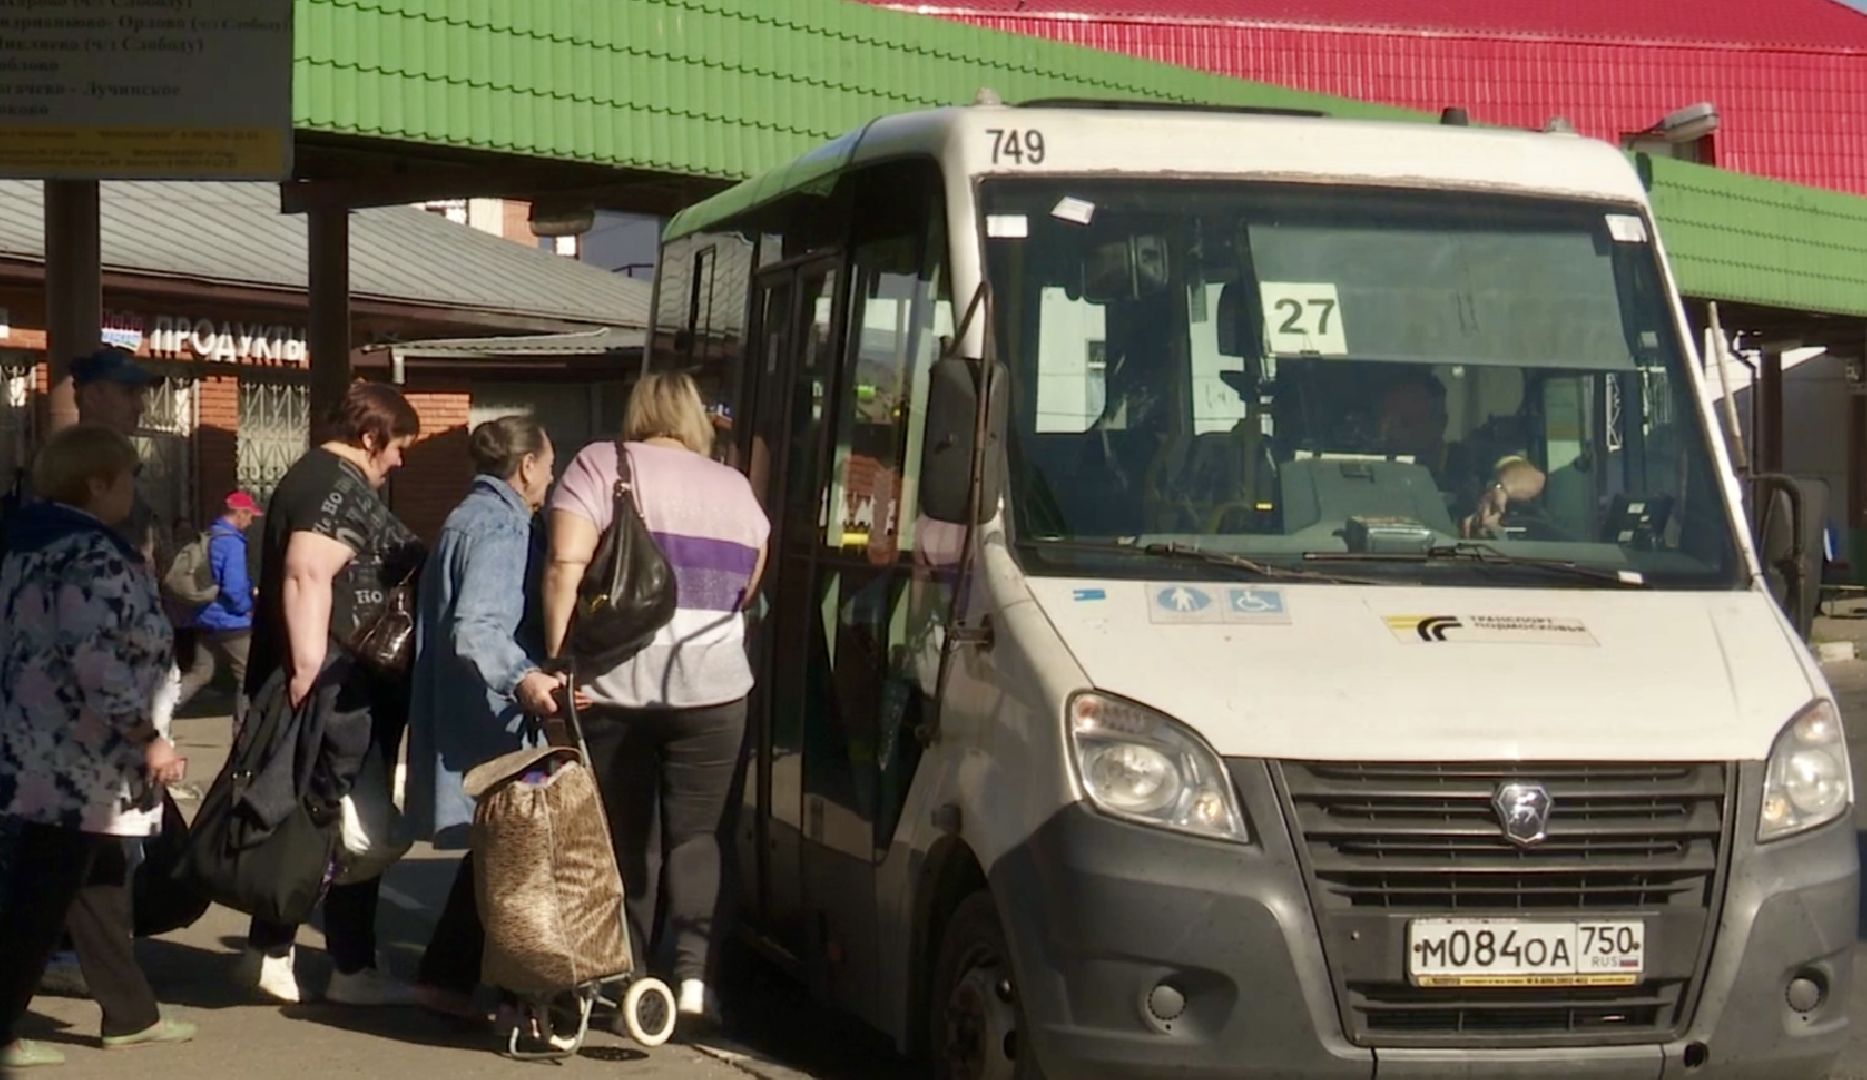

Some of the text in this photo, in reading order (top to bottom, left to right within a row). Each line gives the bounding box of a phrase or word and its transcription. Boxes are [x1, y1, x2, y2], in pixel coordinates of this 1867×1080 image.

[986, 129, 1045, 164] 749
[1273, 297, 1336, 334] 27
[150, 317, 308, 363] ПРОДУКТЫ
[1579, 926, 1632, 955] 750
[1592, 956, 1618, 968] RUS
